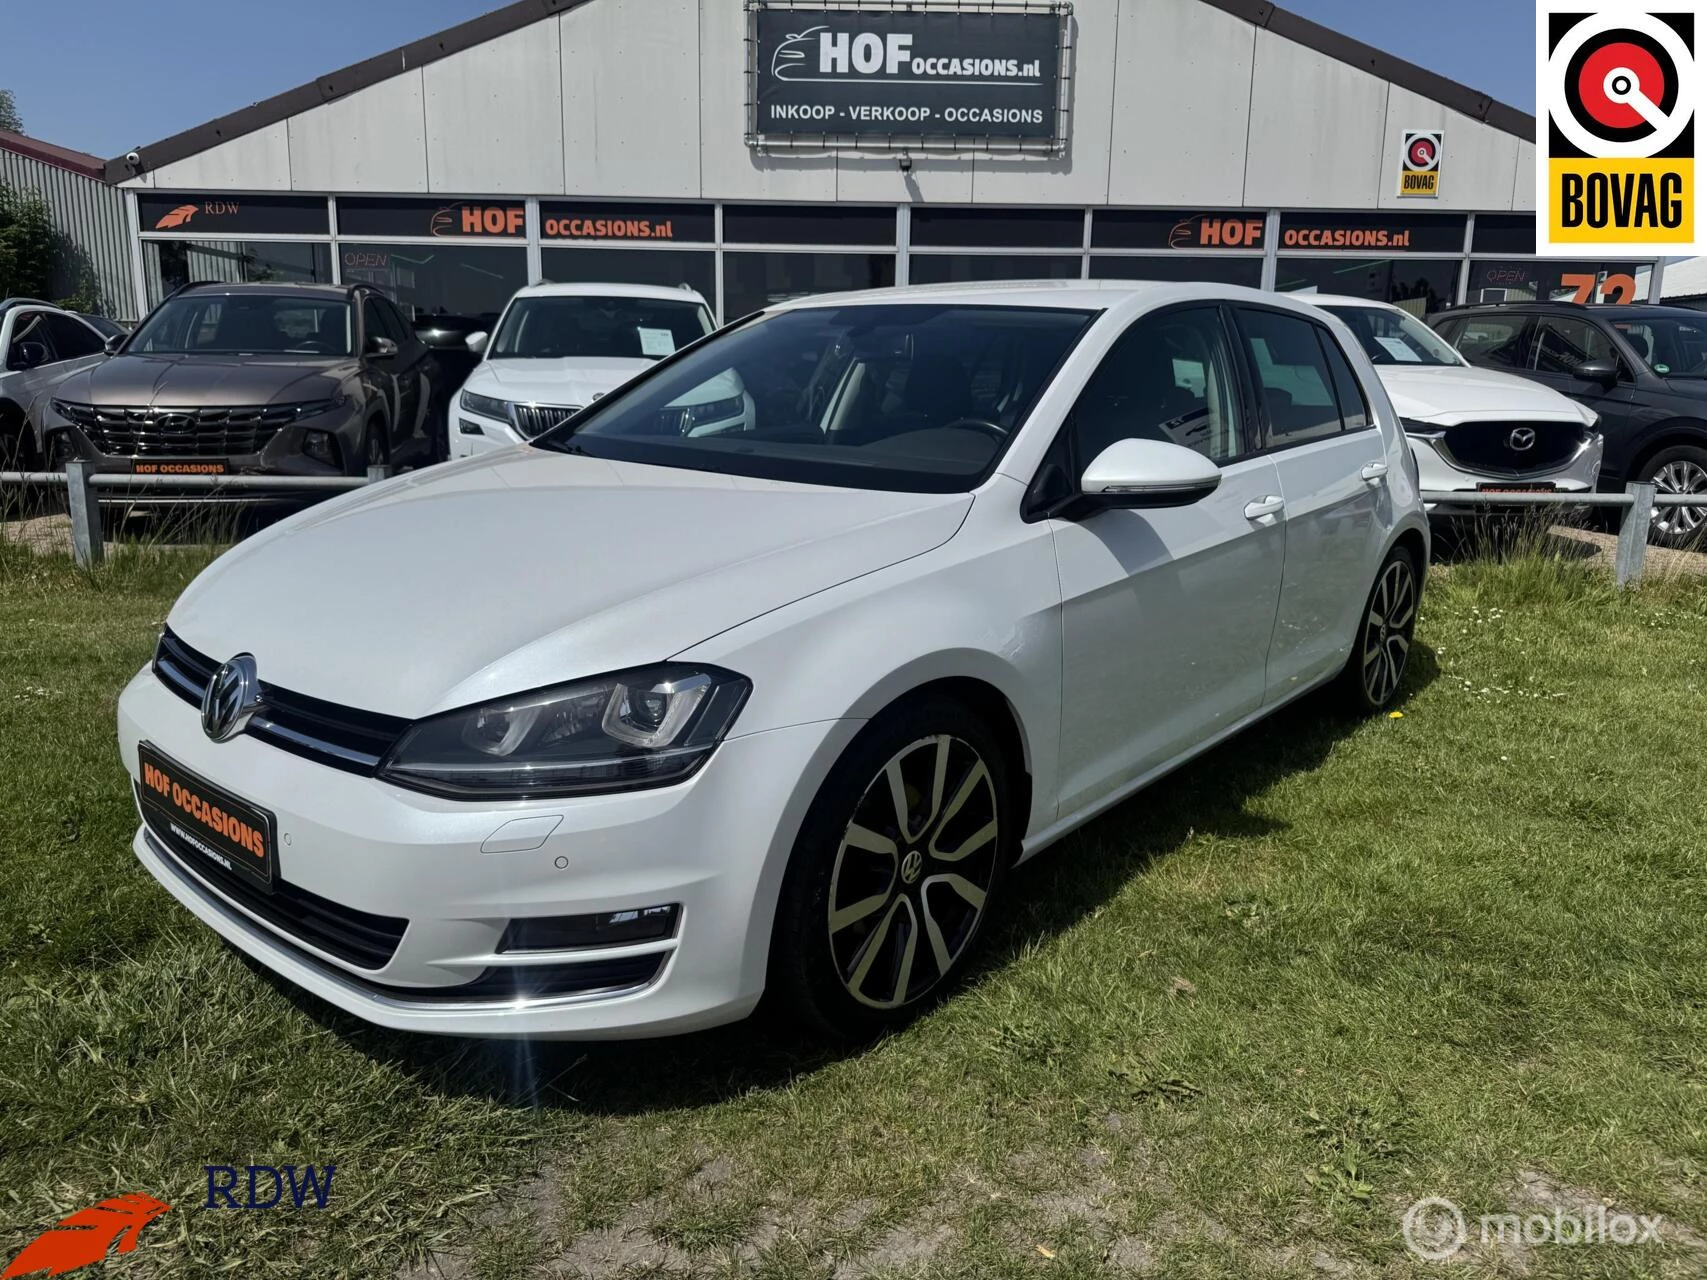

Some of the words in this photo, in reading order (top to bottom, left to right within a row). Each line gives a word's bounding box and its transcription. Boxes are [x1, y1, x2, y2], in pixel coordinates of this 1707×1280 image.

[819, 32, 913, 74] HOF
[911, 57, 1041, 77] OCCASIONS.nl
[770, 104, 835, 120] INKOOP
[849, 106, 931, 122] VERKOOP
[944, 107, 1043, 124] OCCASIONS
[1403, 173, 1435, 190] BOVAG
[204, 201, 240, 215] RDW
[461, 206, 525, 234] HOF
[545, 219, 673, 238] OCCASIONS.nl
[1200, 218, 1263, 246] HOF
[1283, 229, 1410, 247] OCCASIONS.nl
[344, 253, 387, 266] OPEN
[1487, 270, 1526, 282] OPEN
[136, 464, 158, 473] HOF
[160, 464, 225, 473] OCCASIONS
[144, 762, 171, 798] HOF
[172, 782, 265, 858] OCCASIONS
